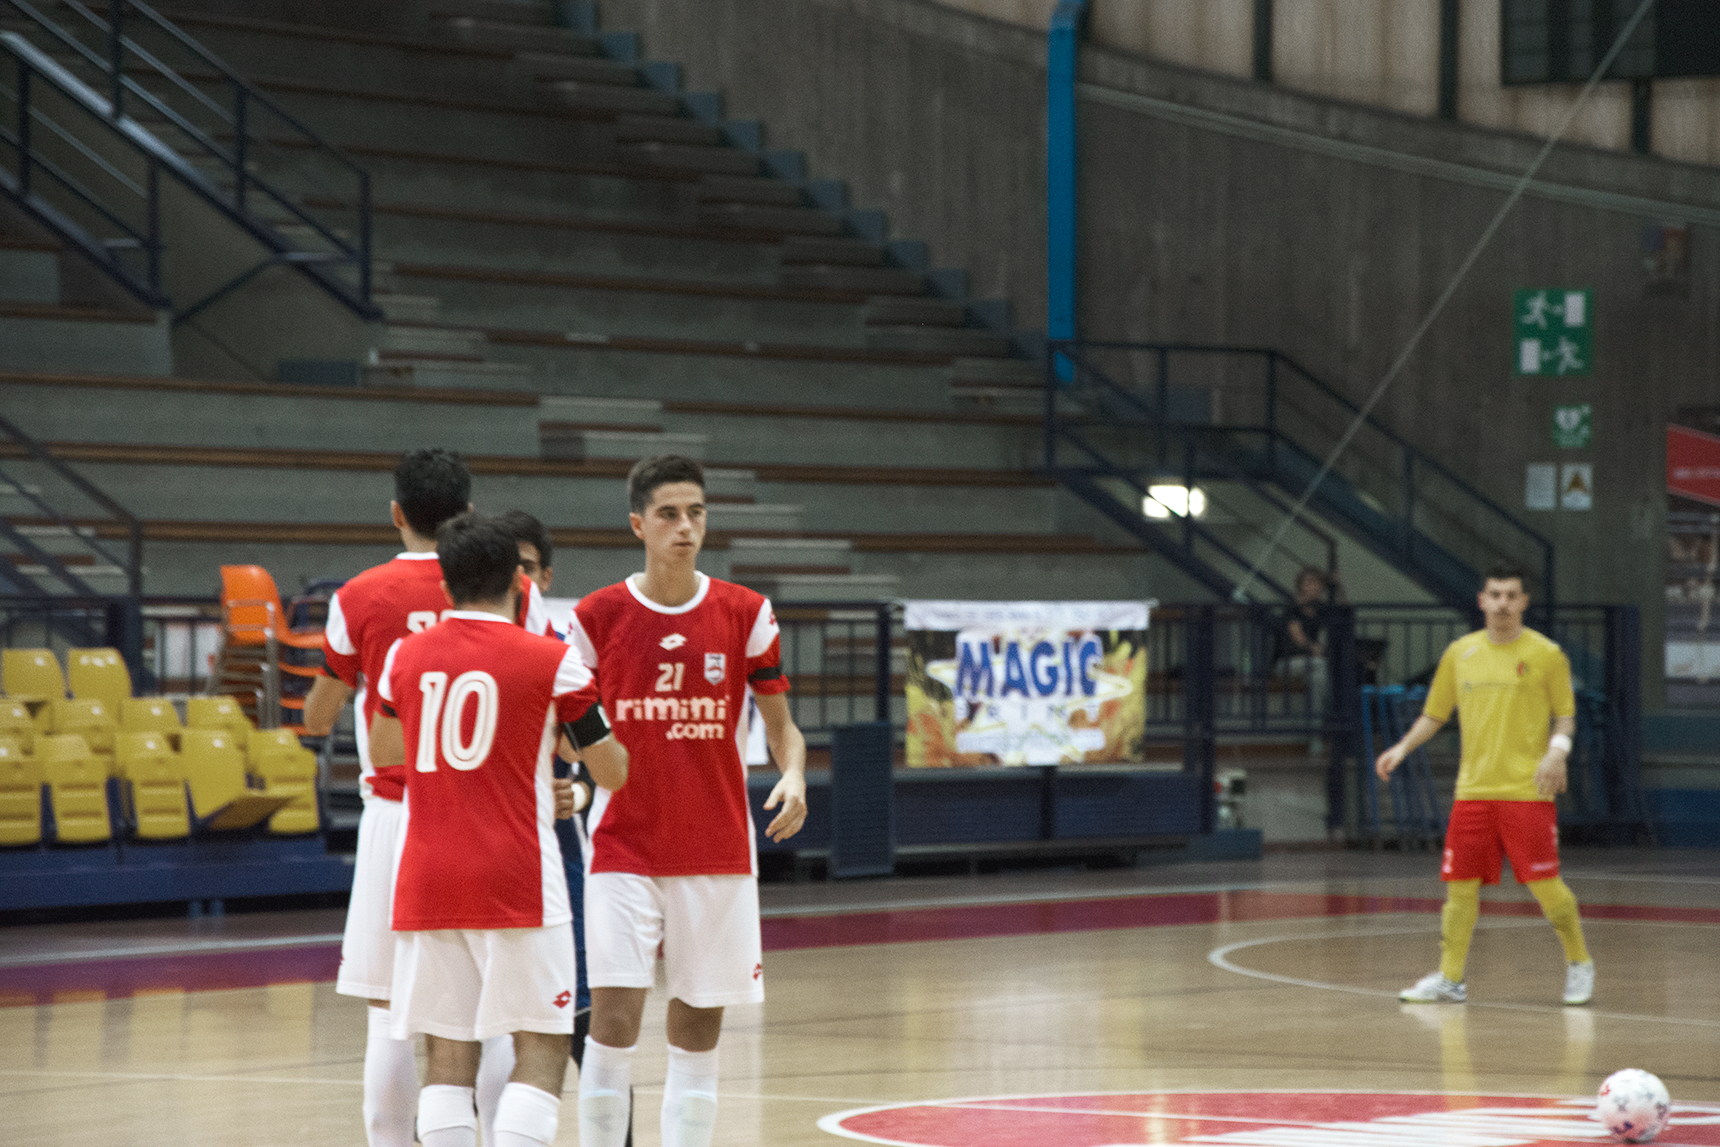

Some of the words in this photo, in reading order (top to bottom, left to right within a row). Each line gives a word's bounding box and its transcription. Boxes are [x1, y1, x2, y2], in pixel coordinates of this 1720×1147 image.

[655, 662, 685, 692] 21
[954, 641, 1098, 697] MAGIC
[416, 670, 498, 773] 10
[615, 696, 727, 721] rimini
[666, 723, 725, 741] .com
